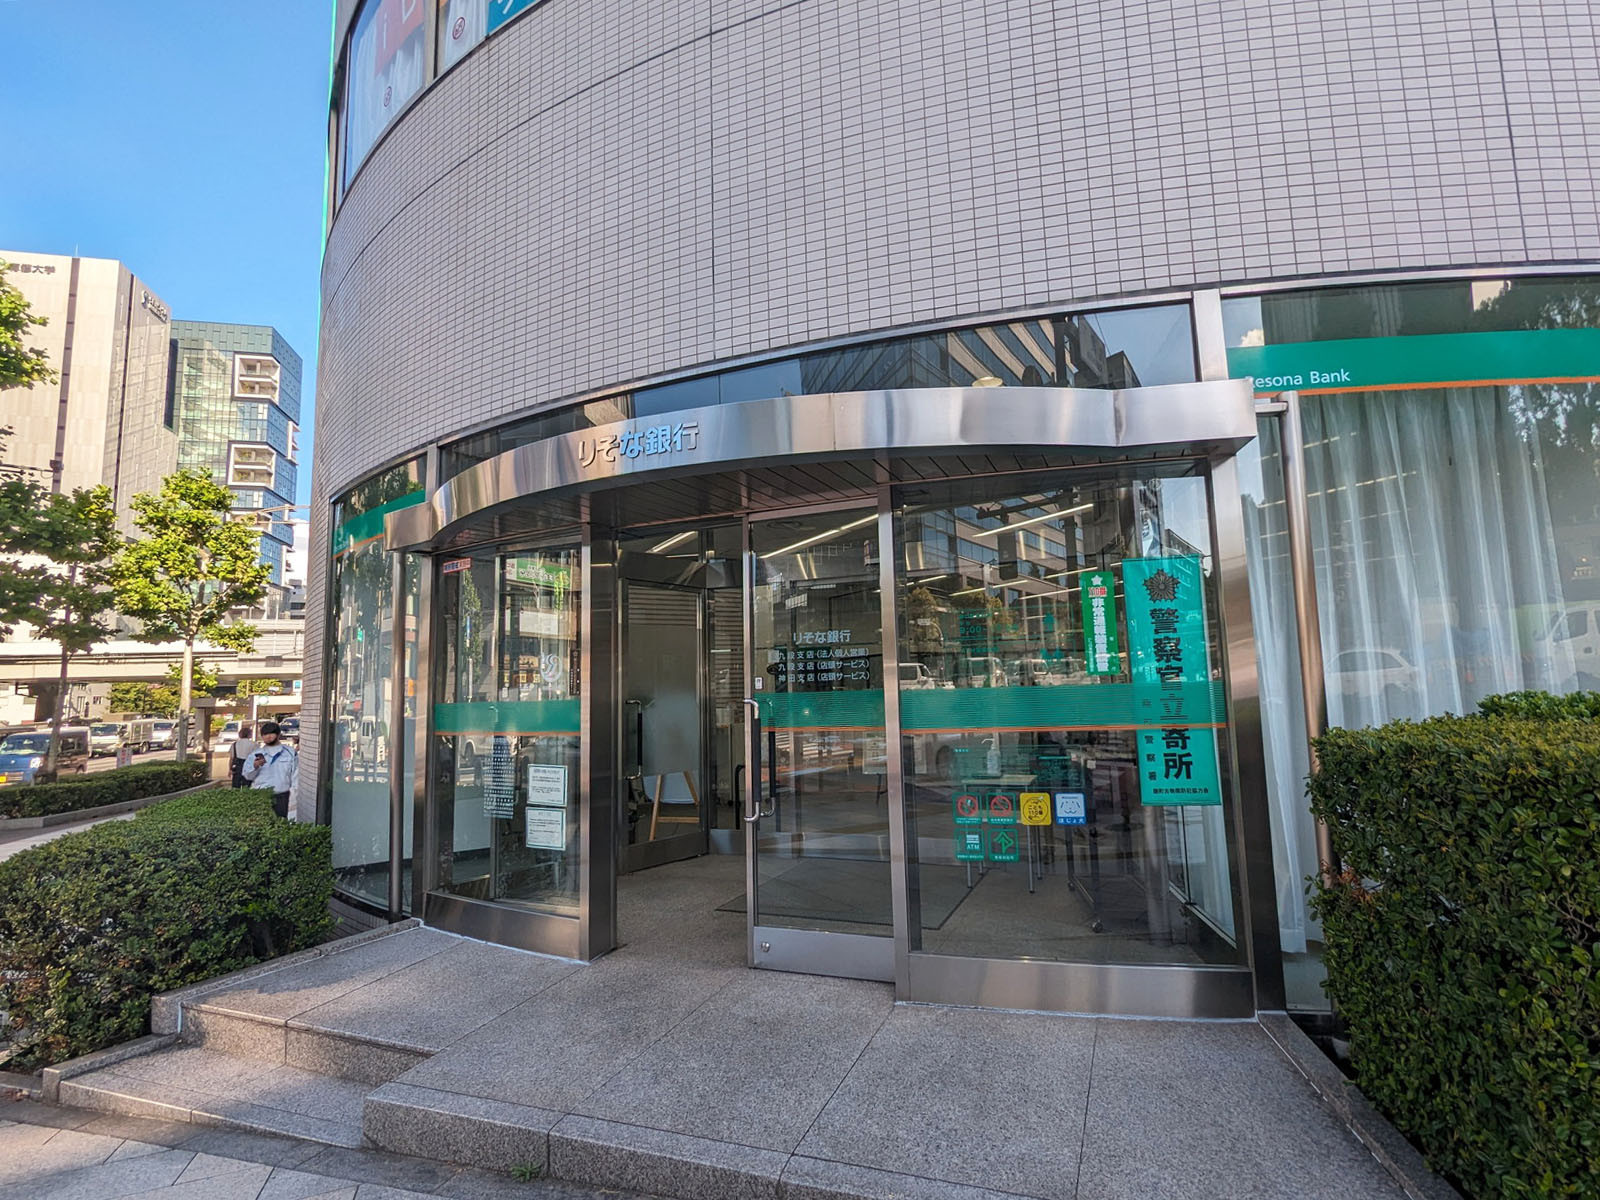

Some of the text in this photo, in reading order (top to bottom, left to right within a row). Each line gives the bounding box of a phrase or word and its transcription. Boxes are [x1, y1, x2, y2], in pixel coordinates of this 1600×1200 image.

[1310, 368, 1351, 384] Bank
[579, 422, 699, 468] りそな銀行
[793, 630, 851, 645] りそな銀行
